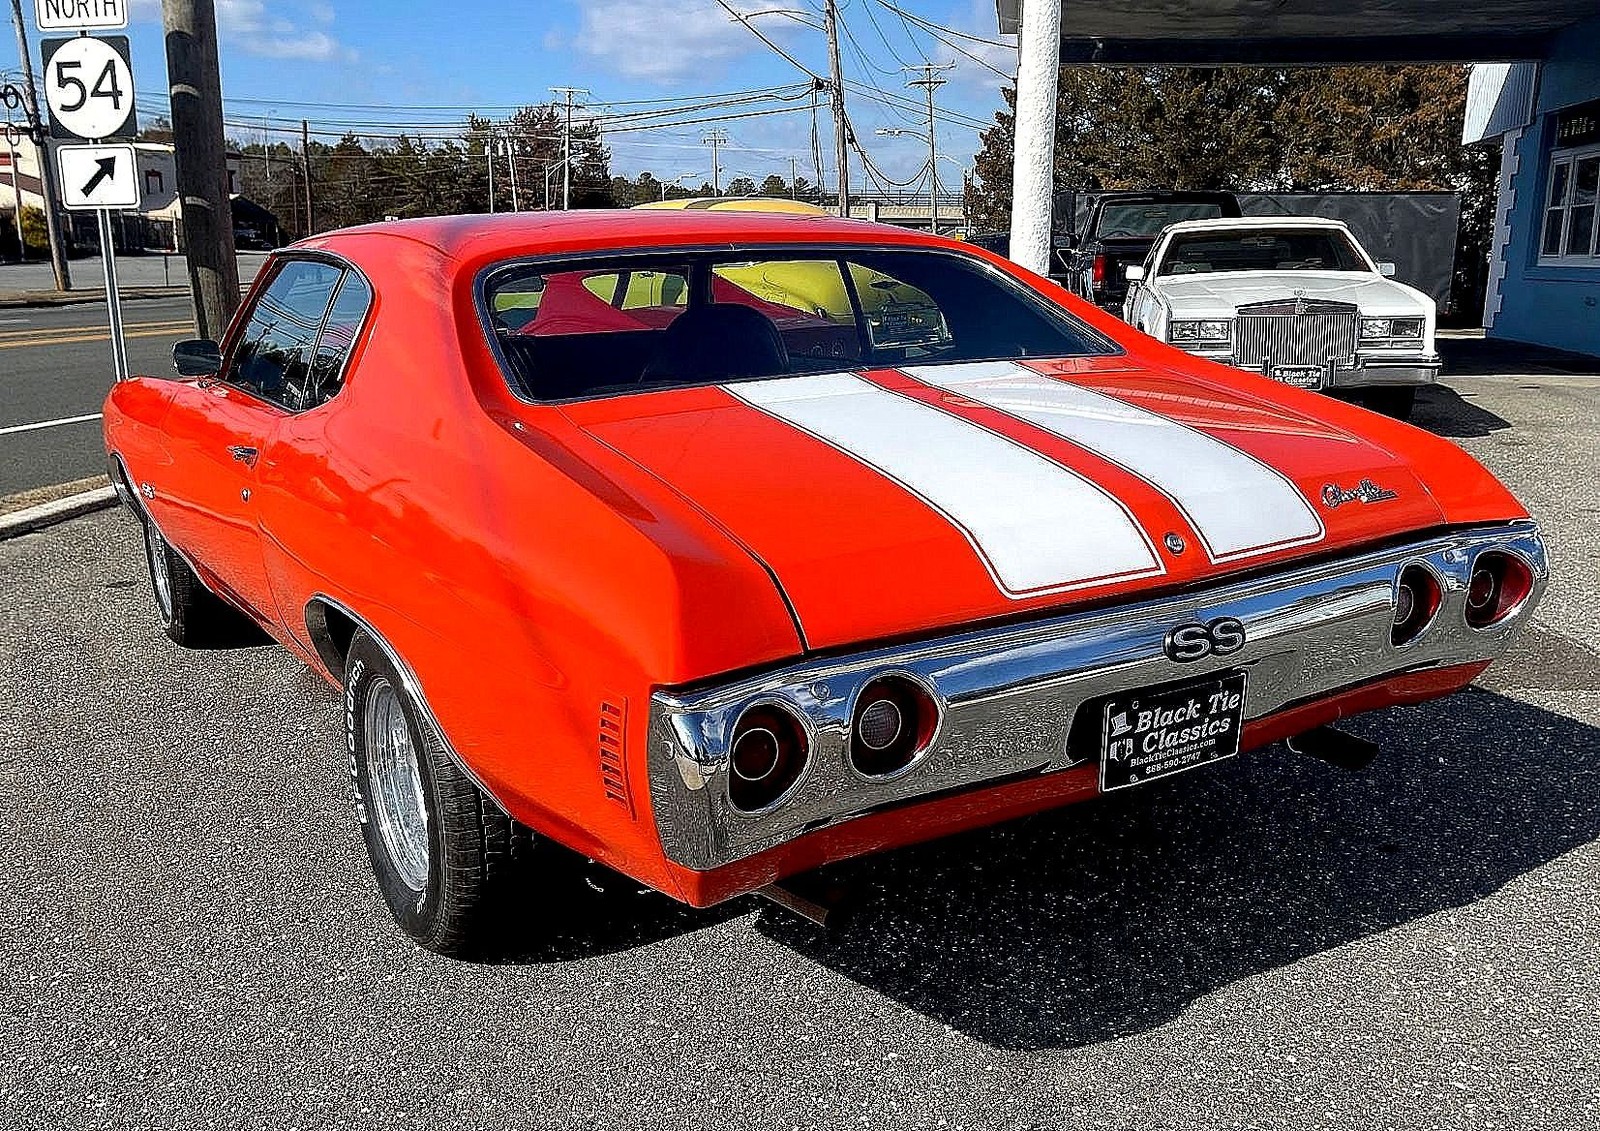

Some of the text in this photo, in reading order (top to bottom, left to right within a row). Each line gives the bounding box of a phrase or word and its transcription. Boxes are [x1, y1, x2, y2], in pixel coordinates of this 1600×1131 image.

[56, 59, 123, 112] 54
[1283, 370, 1320, 378] Black Tie
[1167, 618, 1245, 662] SS
[1134, 690, 1240, 734] Black Tie
[1129, 738, 1216, 768] BlackTieClassics.com
[1142, 716, 1231, 753] Classics
